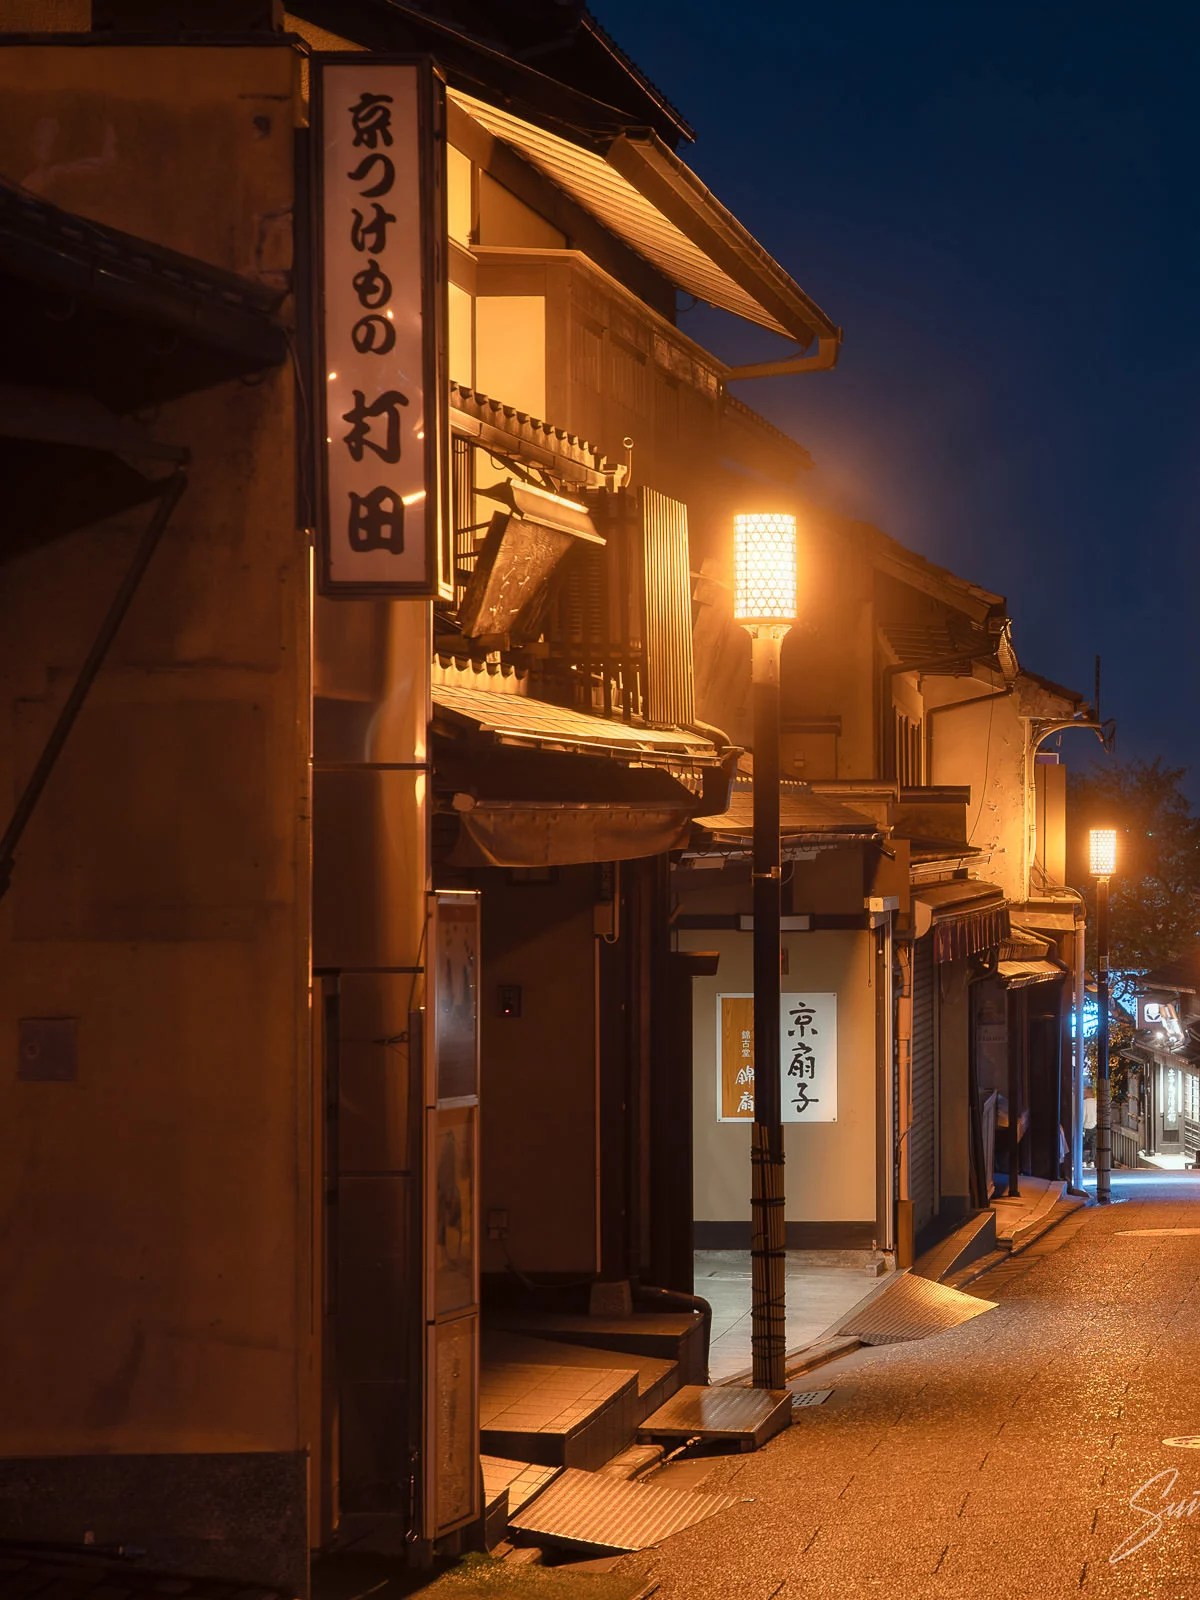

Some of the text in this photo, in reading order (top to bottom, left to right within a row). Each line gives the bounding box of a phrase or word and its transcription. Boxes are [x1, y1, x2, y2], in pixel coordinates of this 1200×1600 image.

[341, 92, 410, 555] 京つけもの 打田
[787, 1002, 820, 1114] 京扇子
